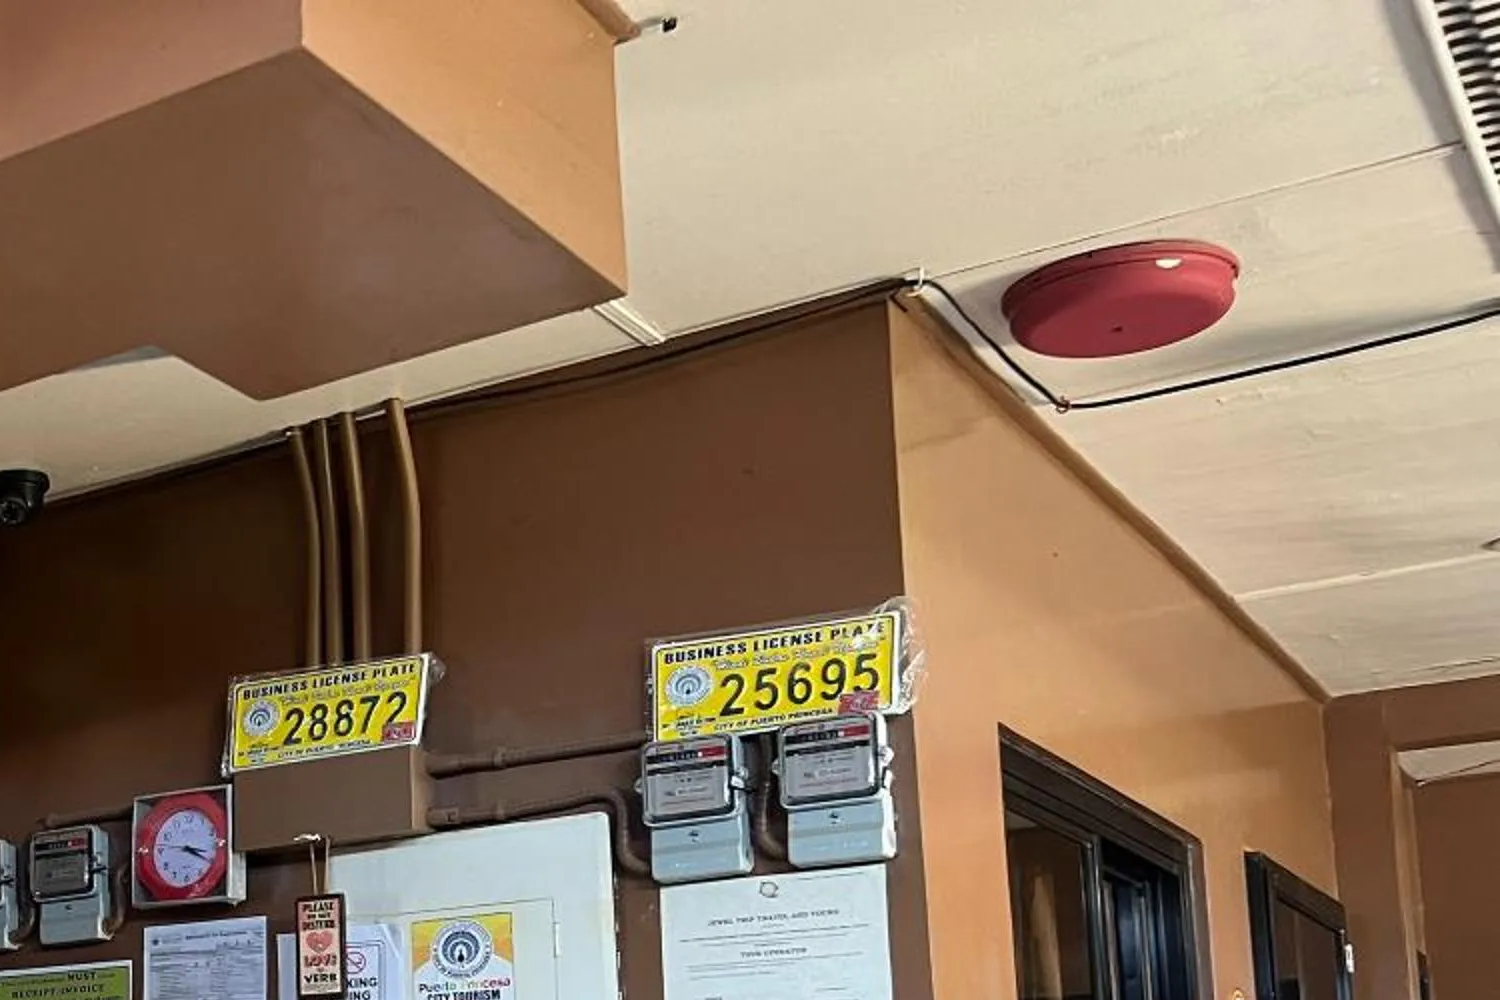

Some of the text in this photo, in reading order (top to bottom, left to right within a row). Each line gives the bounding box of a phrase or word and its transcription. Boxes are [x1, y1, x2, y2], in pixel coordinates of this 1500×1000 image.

[664, 641, 747, 665] BUSINESS
[753, 631, 823, 651] LICENSE
[830, 620, 885, 640] PLATE
[243, 677, 308, 699] BUSINESS
[312, 670, 368, 688] LICENSE
[372, 664, 415, 679] PLATE
[719, 653, 879, 717] 25695
[283, 691, 407, 746] 28872
[302, 902, 334, 913] PLEASE
[304, 954, 337, 968] LOVE
[67, 972, 97, 981] MUST
[303, 973, 337, 984] VERB
